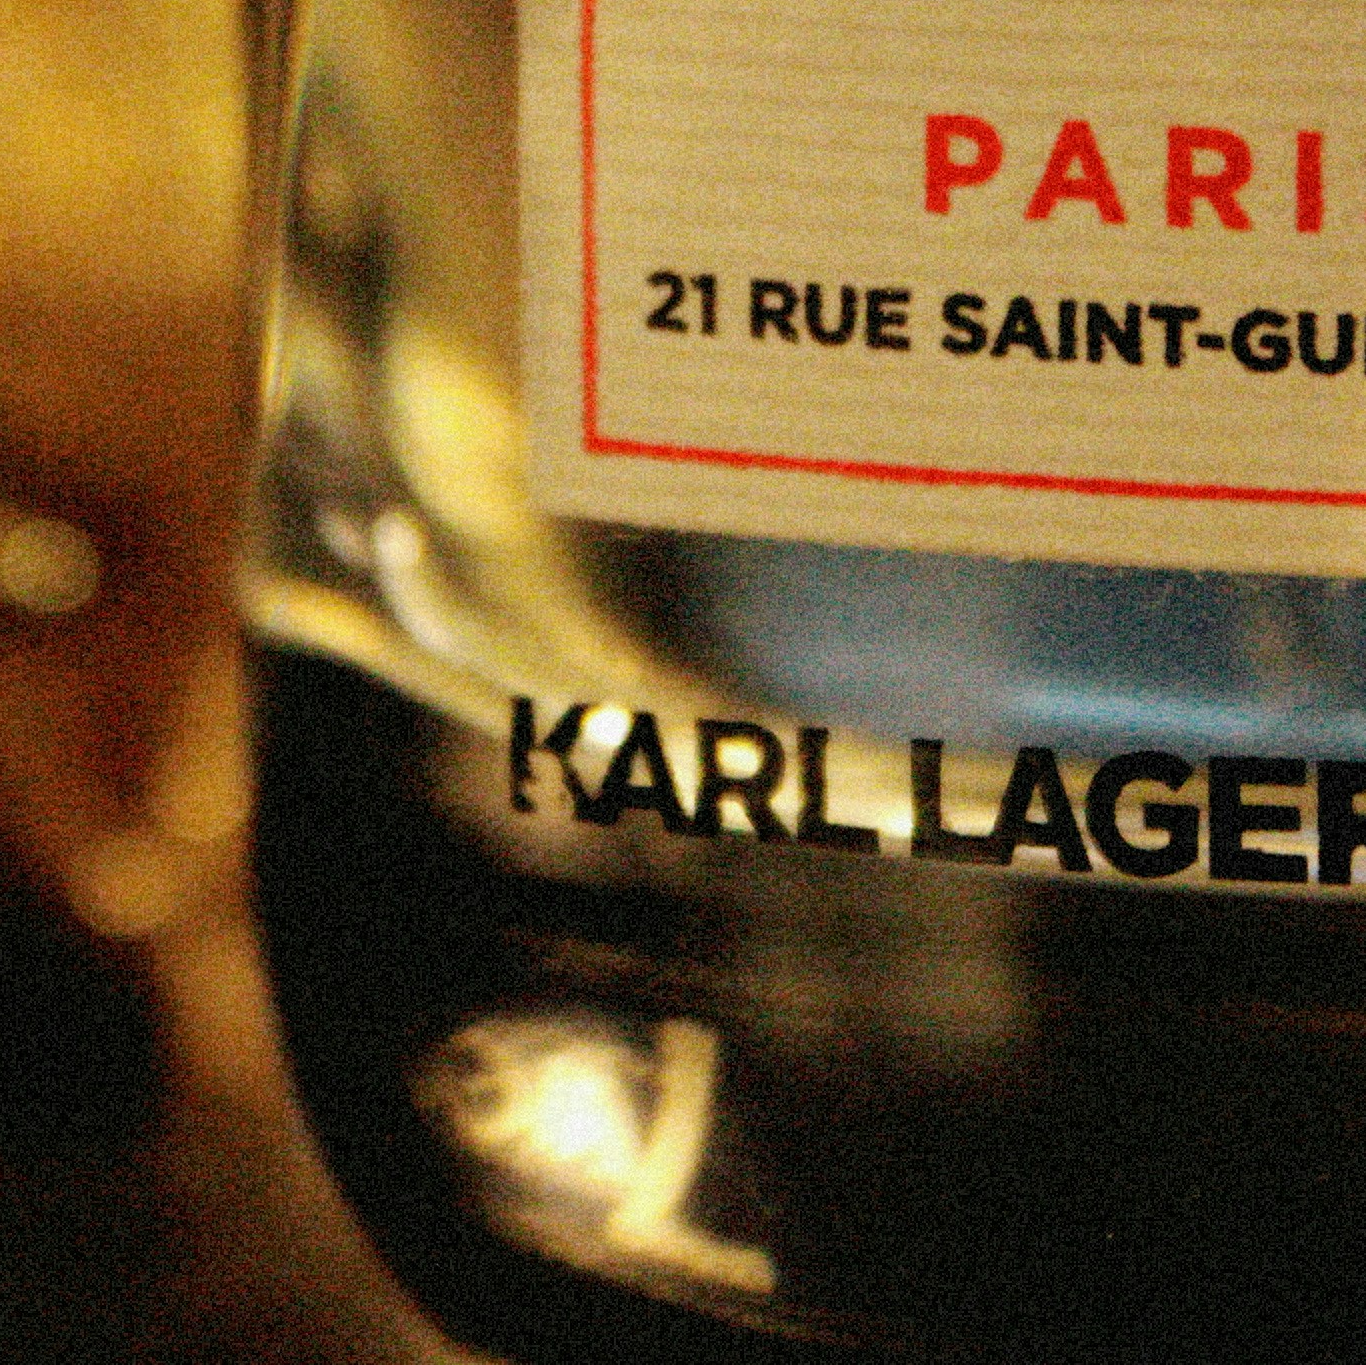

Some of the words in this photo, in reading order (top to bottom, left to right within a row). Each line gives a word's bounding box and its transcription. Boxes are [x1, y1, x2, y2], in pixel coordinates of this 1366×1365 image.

[644, 271, 718, 335] 21
[749, 279, 911, 352] RUE
[509, 693, 880, 855] KARL
